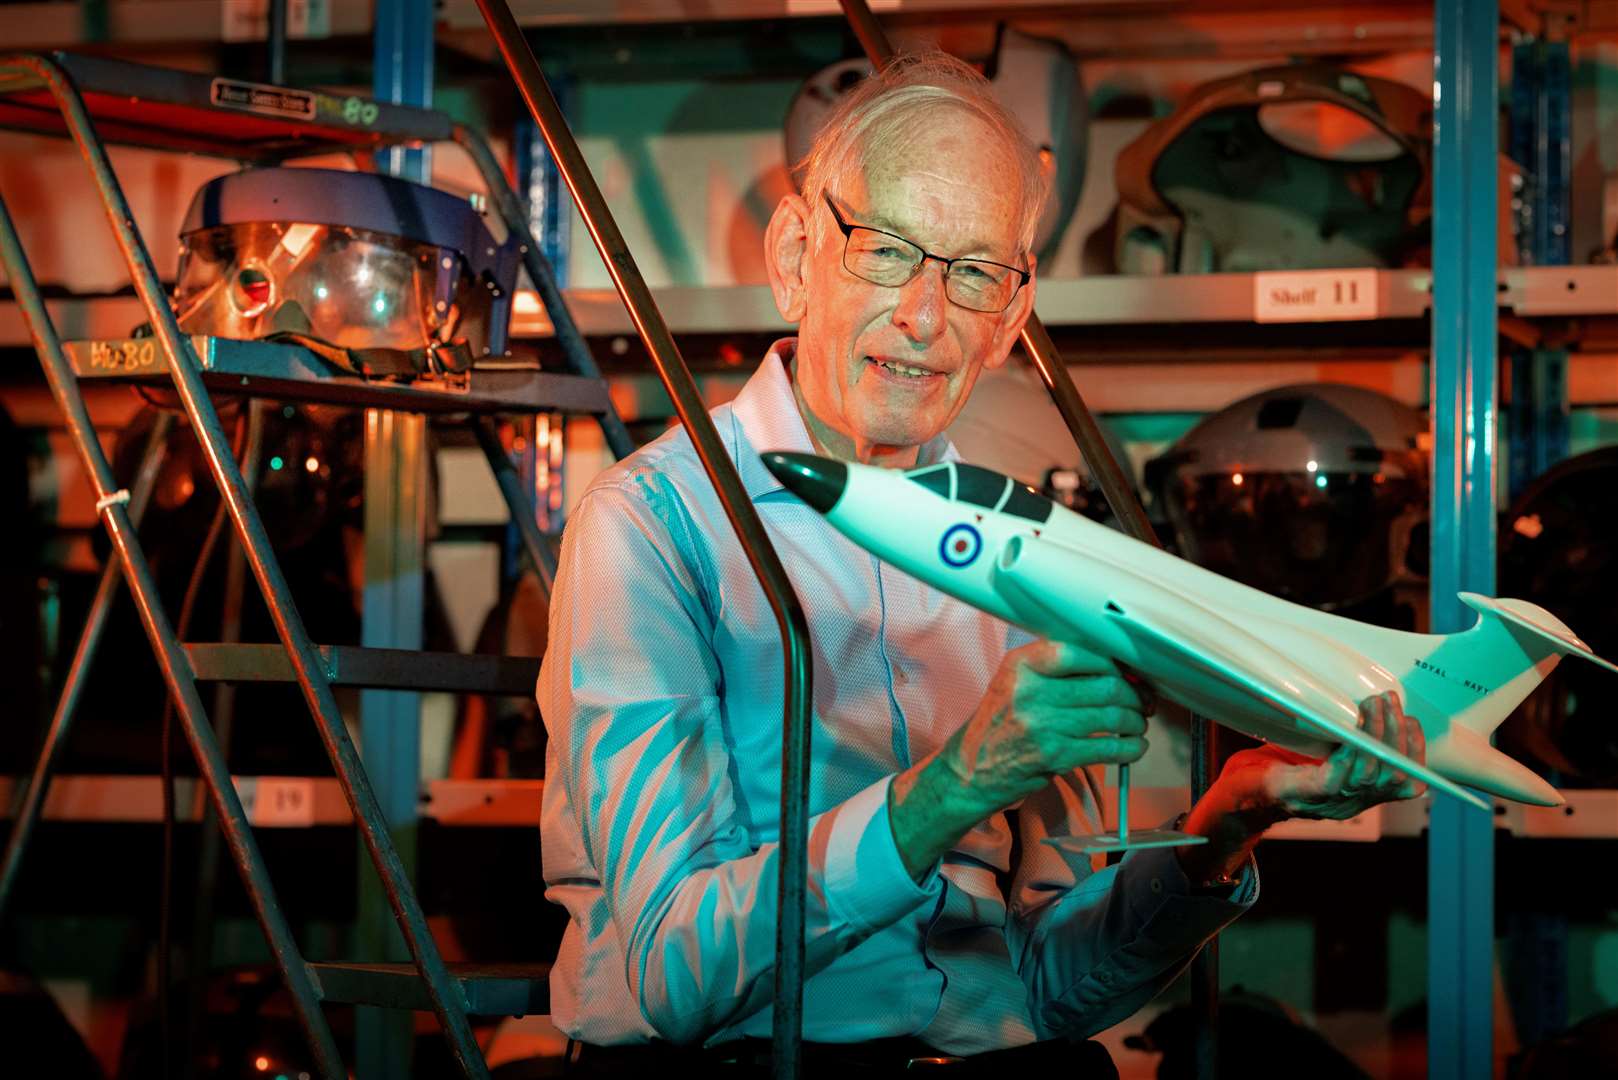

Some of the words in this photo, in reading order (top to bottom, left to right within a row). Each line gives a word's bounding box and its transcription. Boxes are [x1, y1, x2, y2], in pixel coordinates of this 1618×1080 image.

[1270, 287, 1317, 305] Shelf
[1334, 281, 1358, 304] 11
[1415, 659, 1446, 678] ROYAL
[1464, 680, 1489, 695] NAVY
